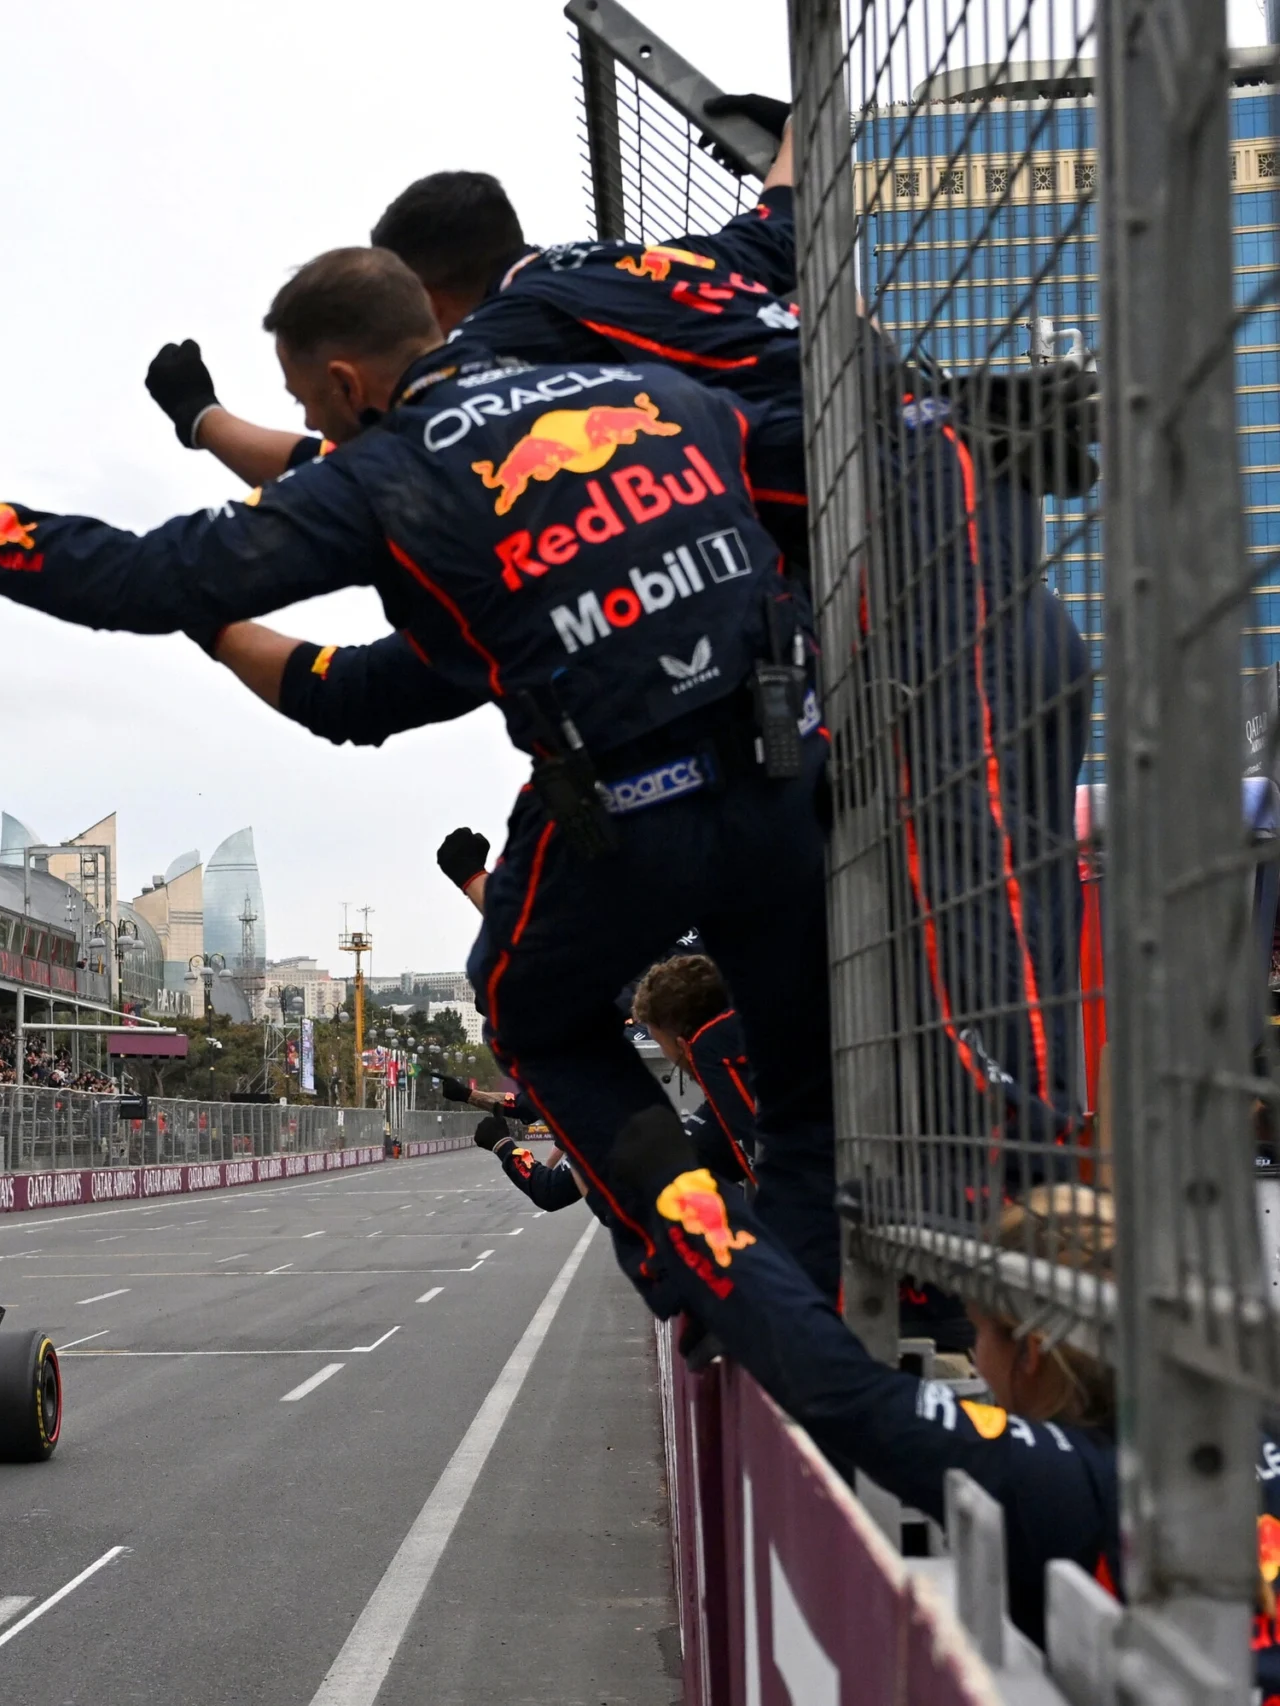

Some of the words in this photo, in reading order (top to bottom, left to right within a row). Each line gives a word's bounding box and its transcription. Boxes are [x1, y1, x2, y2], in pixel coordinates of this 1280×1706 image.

[494, 479, 627, 592] Red
[549, 545, 705, 654] Mobil
[27, 1175, 53, 1207] QATAR
[53, 1173, 82, 1202] AIRWAYS
[91, 1172, 113, 1201] QATAR
[113, 1170, 136, 1198] AIRWAYS
